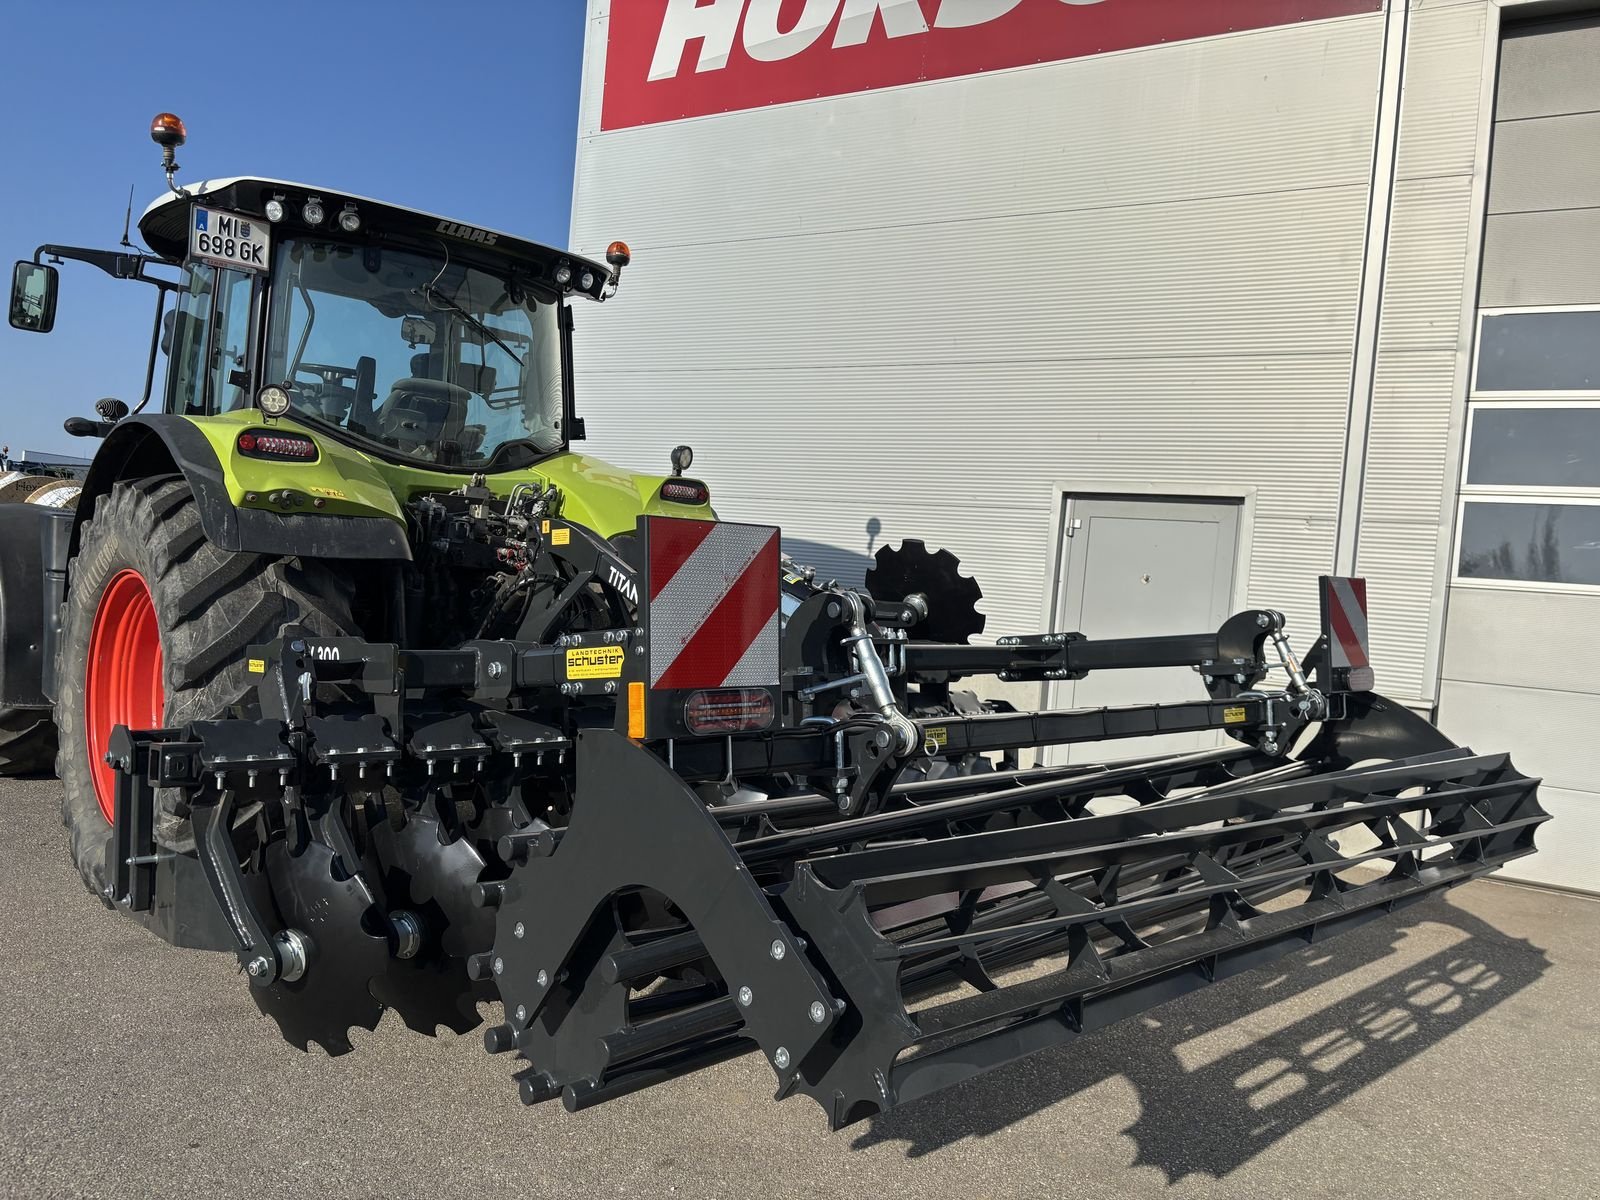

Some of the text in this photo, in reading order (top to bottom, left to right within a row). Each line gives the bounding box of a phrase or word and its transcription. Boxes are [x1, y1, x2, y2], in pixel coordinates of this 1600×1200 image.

[218, 215, 238, 238] MI
[435, 220, 499, 246] CLAAS
[199, 233, 264, 264] 698 GK
[567, 654, 624, 667] schuster
[571, 649, 620, 657] LANDTECHNIK
